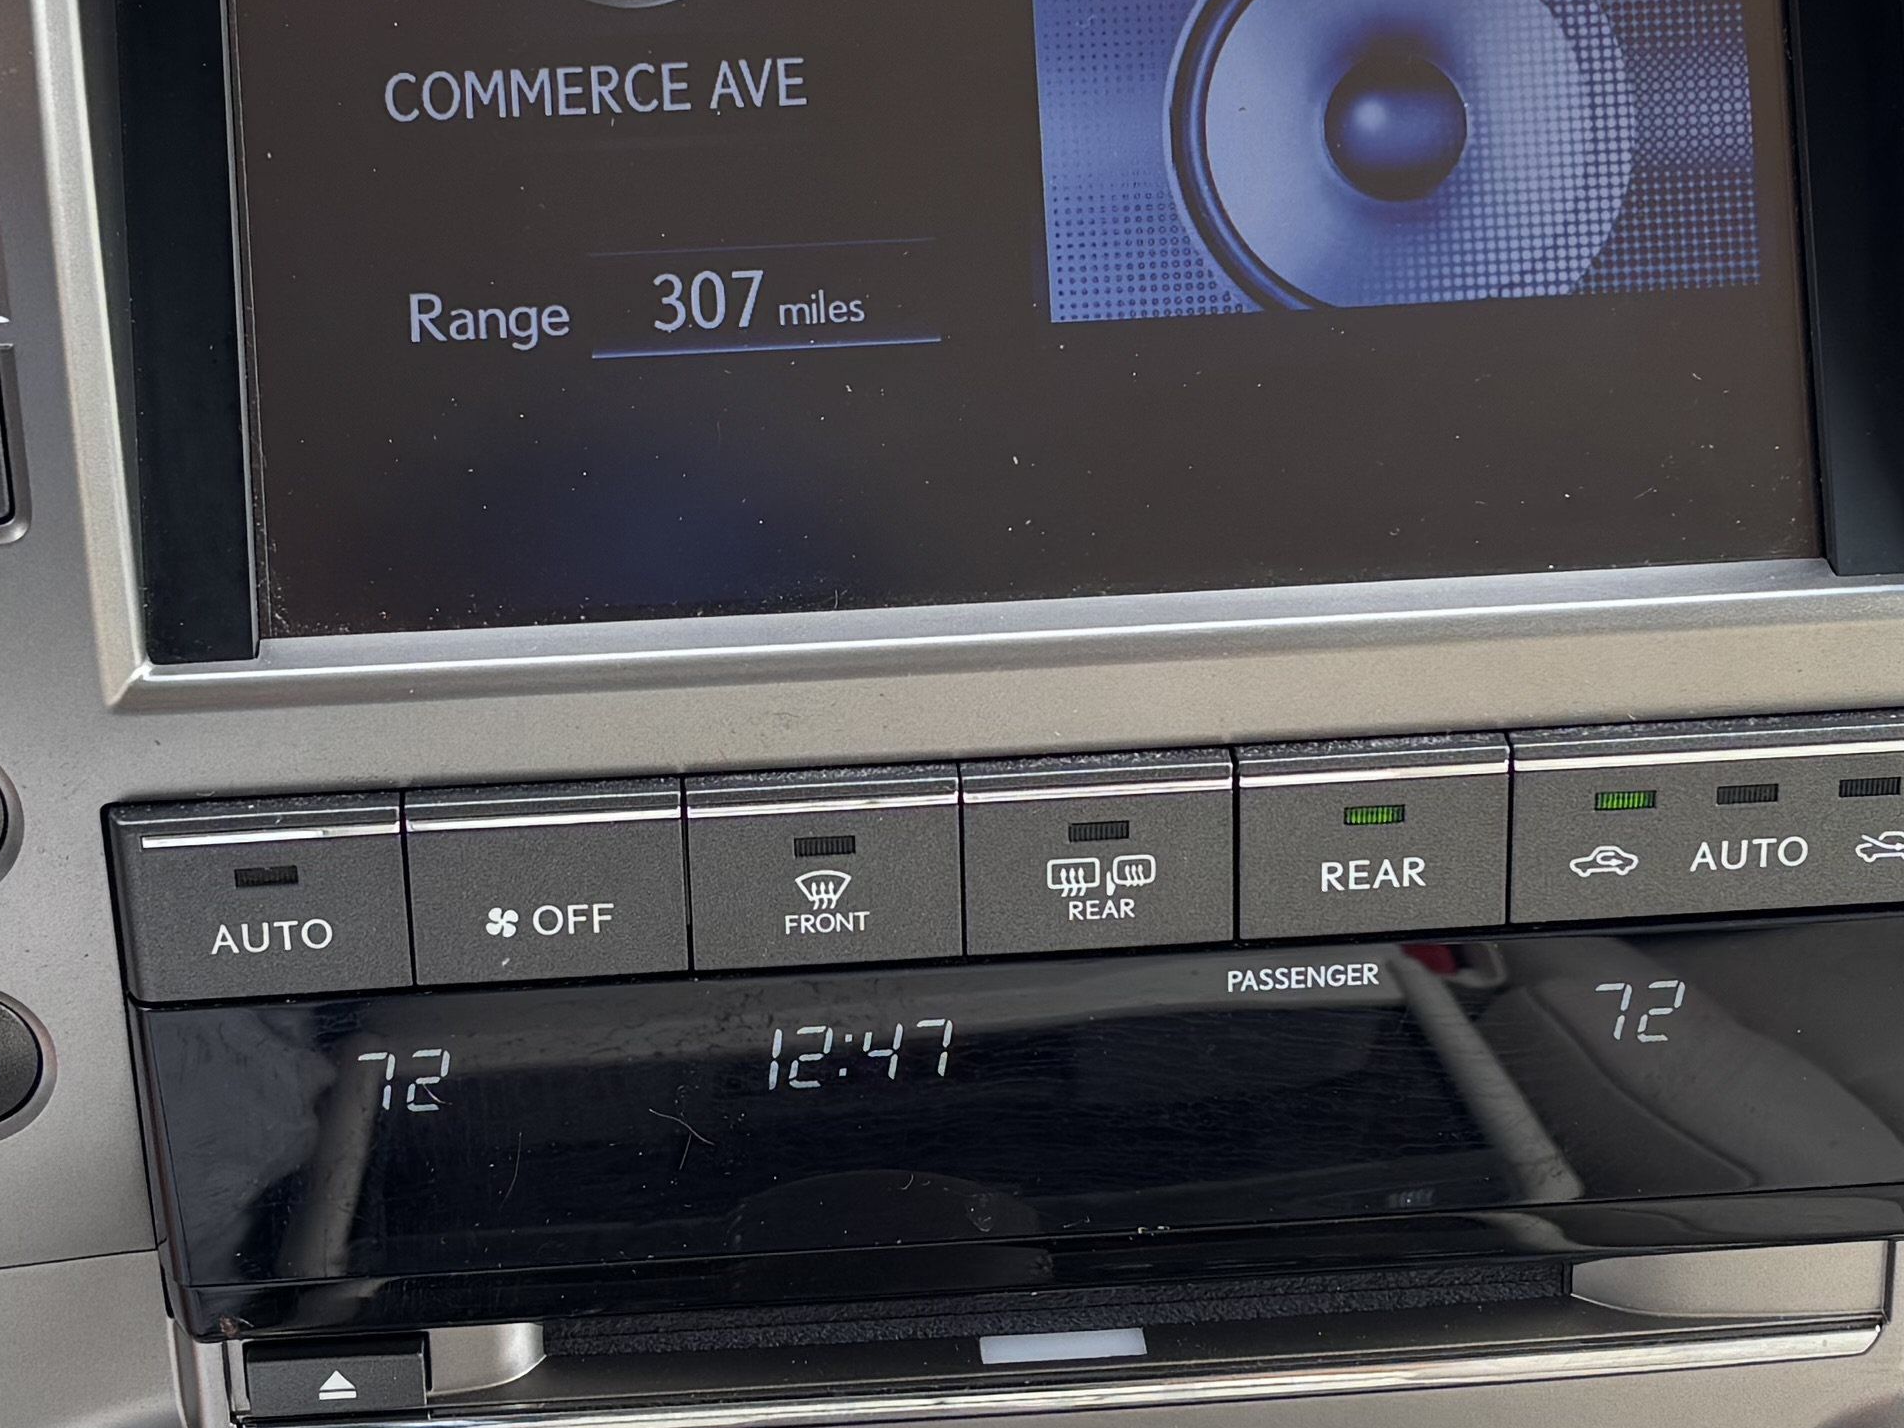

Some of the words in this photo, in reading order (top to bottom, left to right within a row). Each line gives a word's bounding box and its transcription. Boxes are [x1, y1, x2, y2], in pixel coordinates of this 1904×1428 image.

[384, 61, 693, 124] COMMERCE
[709, 57, 809, 112] AVE
[408, 292, 570, 351] Range
[652, 269, 765, 333] 307
[777, 290, 866, 329] miles
[1690, 836, 1809, 873] AUTO
[1320, 856, 1427, 892] REAR
[532, 903, 615, 936] OFF
[784, 910, 871, 936] FRONT
[1068, 897, 1136, 922] REAR
[211, 918, 334, 955] AUTO
[1226, 962, 1380, 993] PASSENGER
[1596, 979, 1686, 1043] 72
[768, 1018, 953, 1090] 12:47
[358, 1048, 451, 1112] 72
